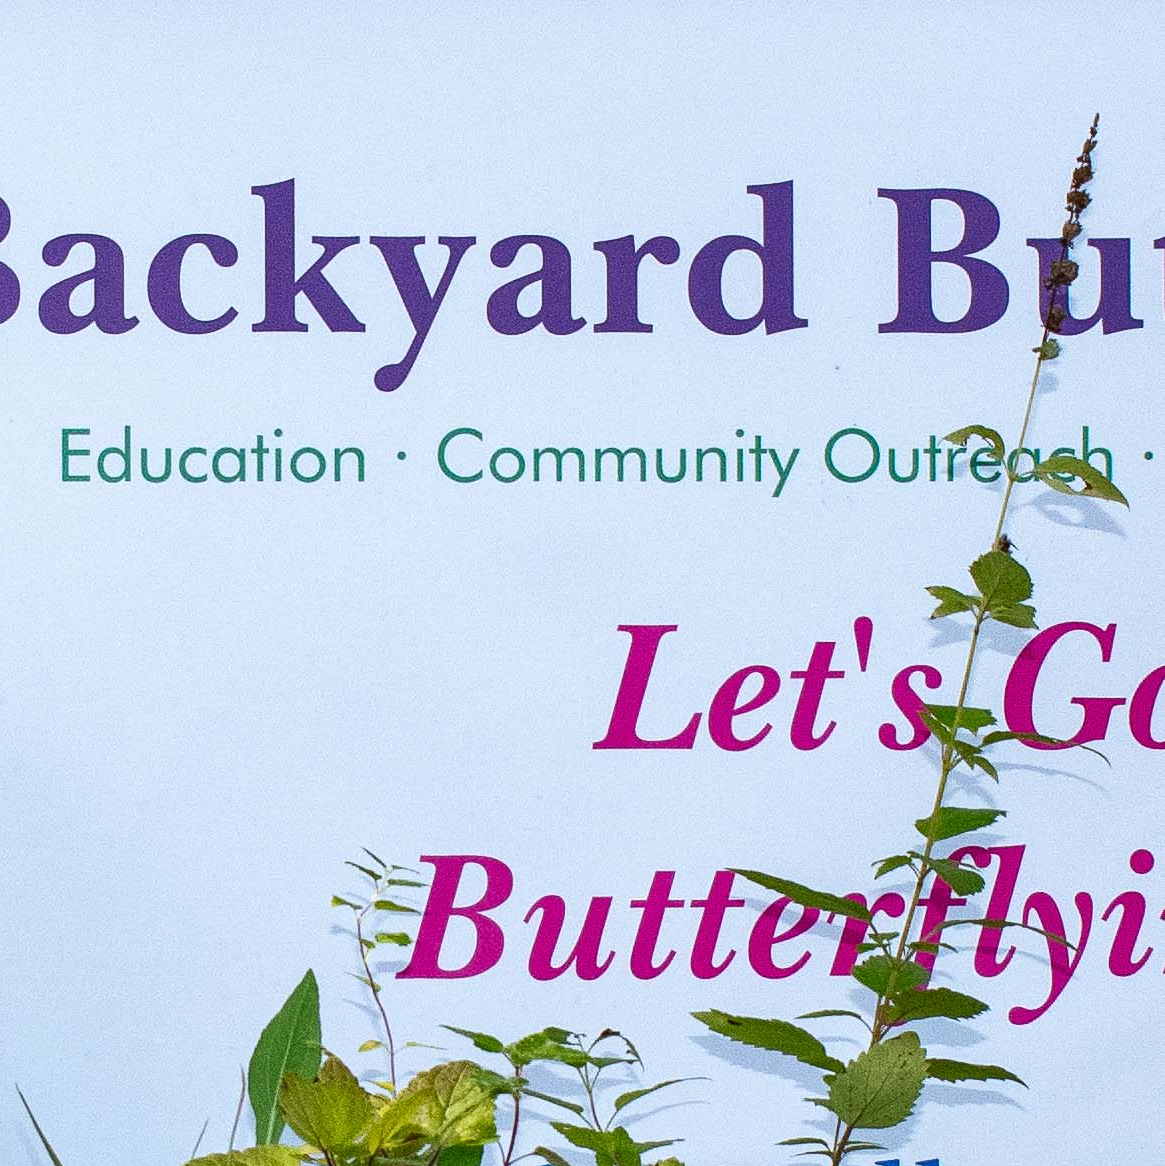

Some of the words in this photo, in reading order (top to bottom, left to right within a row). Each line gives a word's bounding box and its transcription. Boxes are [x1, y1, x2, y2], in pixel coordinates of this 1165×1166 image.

[877, 187, 1165, 336] Bu
[61, 425, 365, 483] Education
[437, 427, 801, 497] Community
[824, 425, 1114, 483] Outreach
[593, 617, 941, 751] Let's
[397, 844, 1165, 1027] Butterflyi
